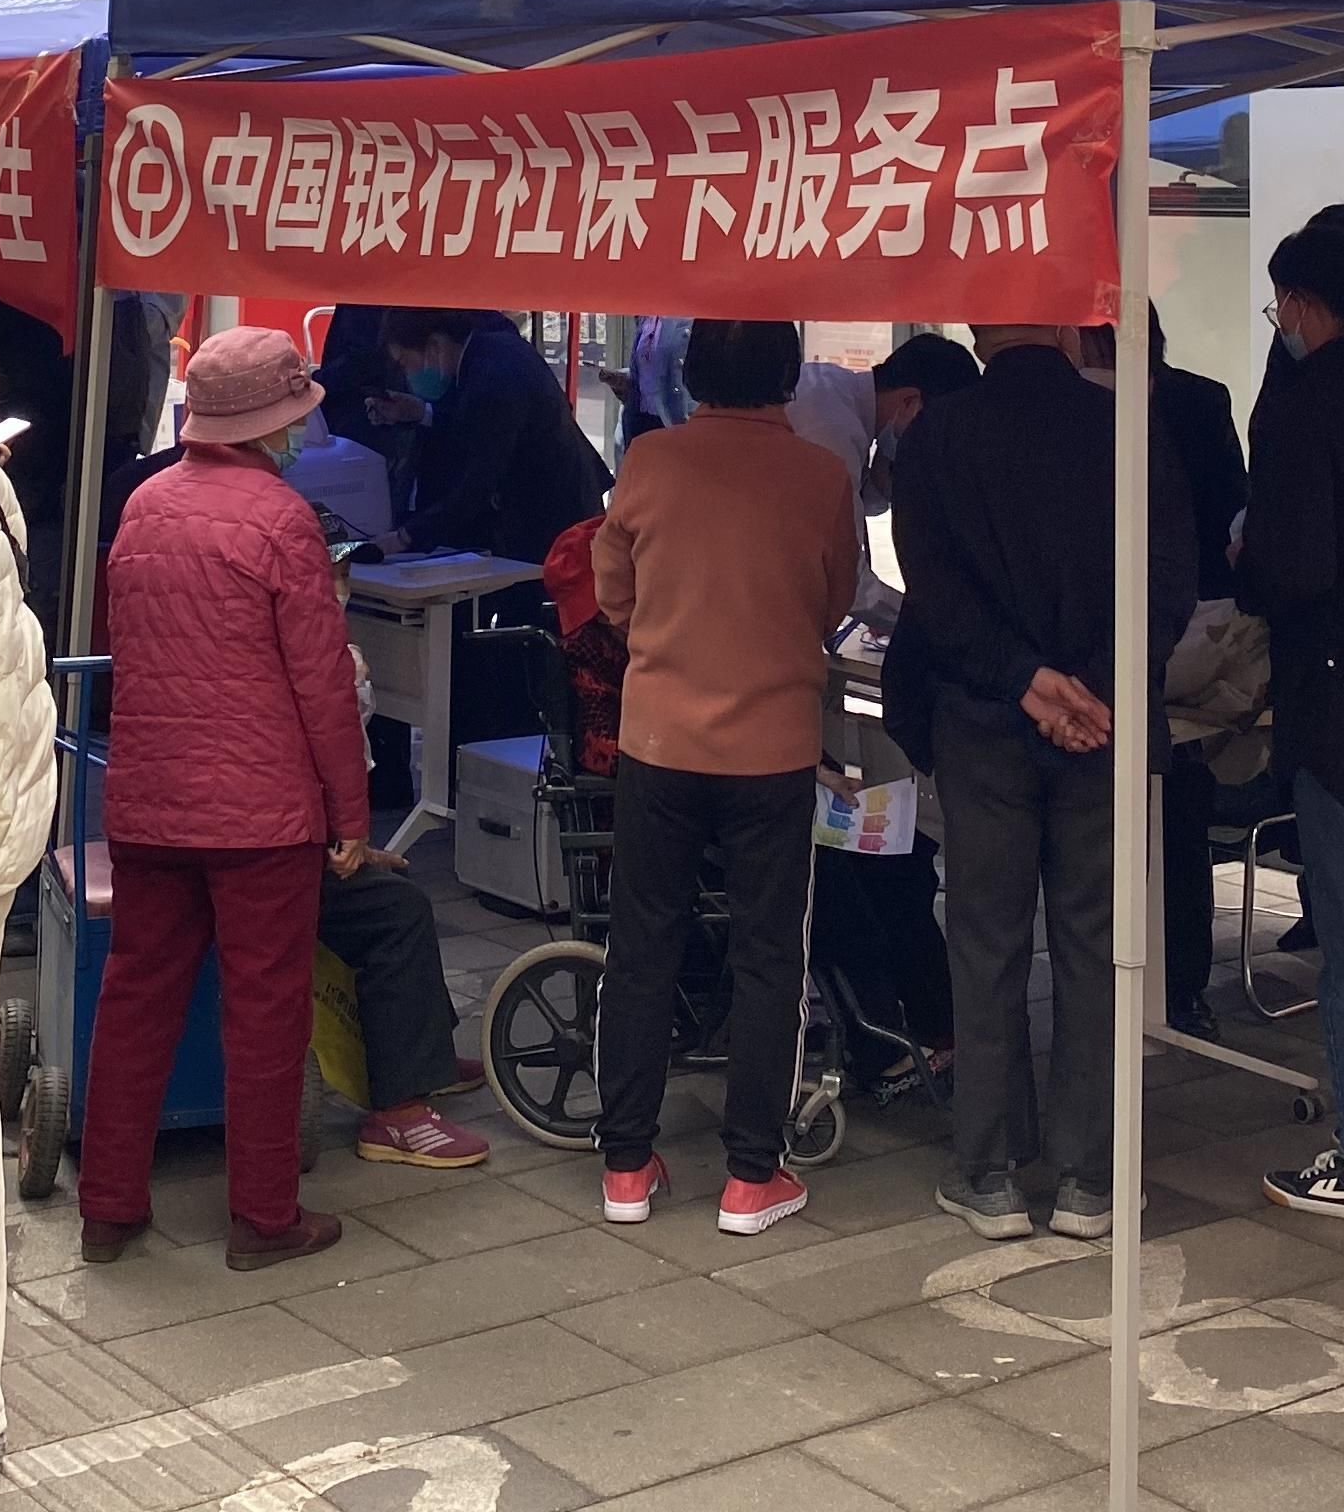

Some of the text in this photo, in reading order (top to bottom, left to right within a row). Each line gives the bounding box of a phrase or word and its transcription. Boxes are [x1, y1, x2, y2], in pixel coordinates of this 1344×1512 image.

[200, 66, 1059, 261] 中国银行社保卡服务点
